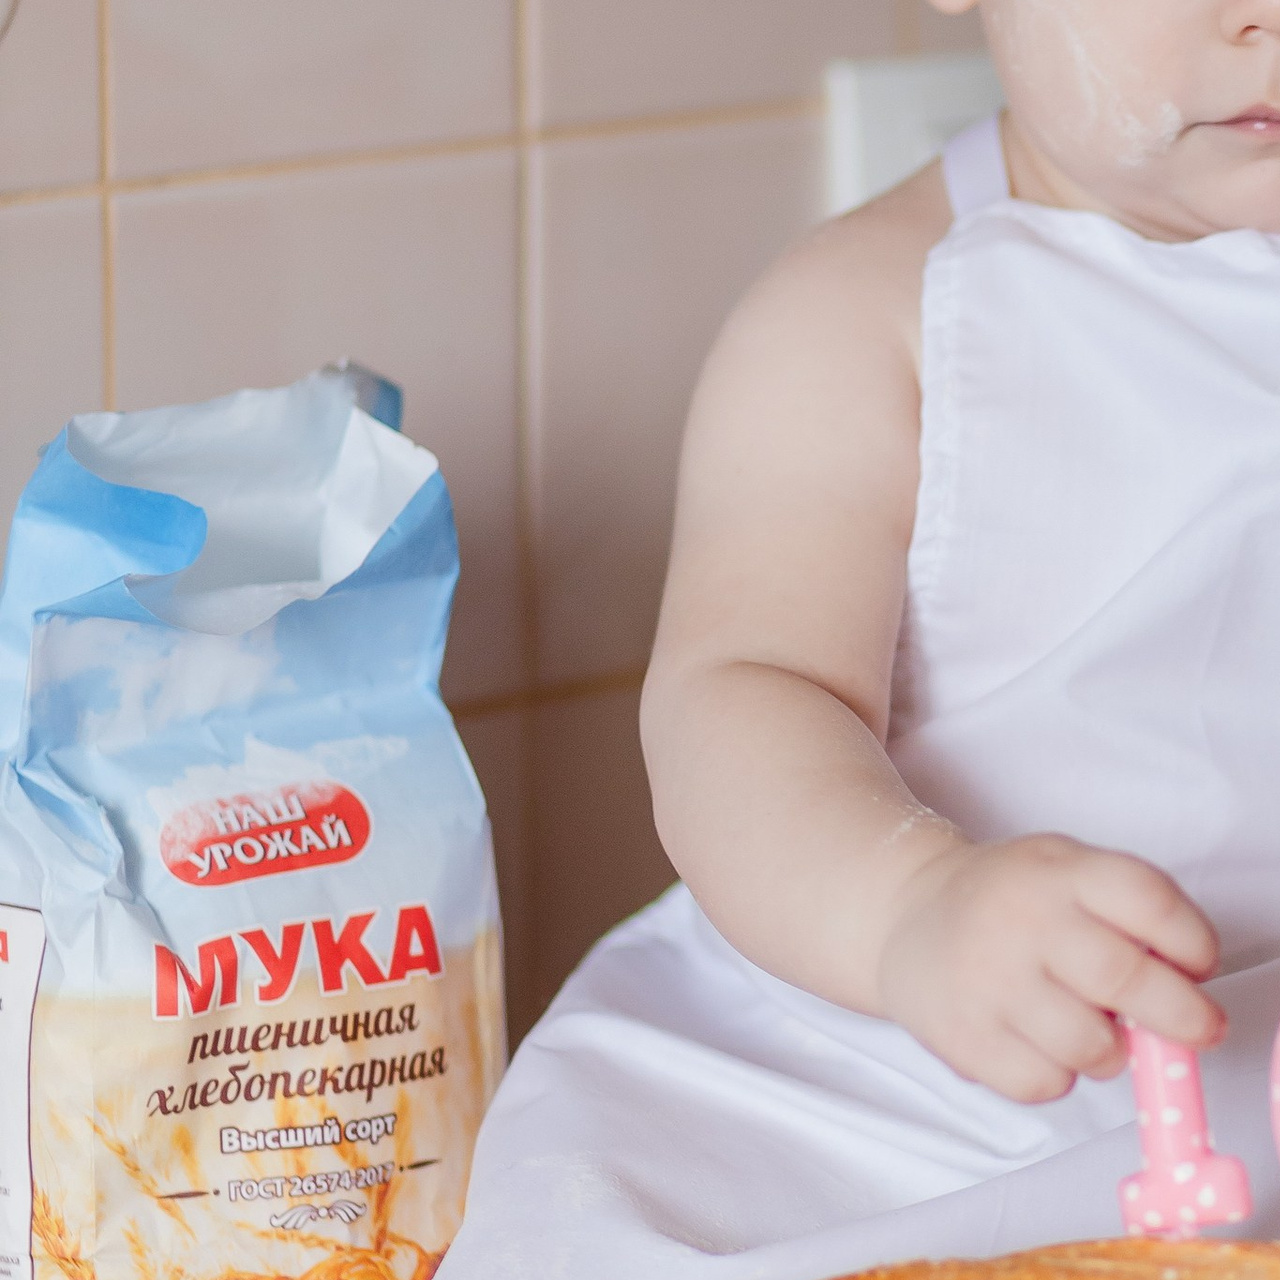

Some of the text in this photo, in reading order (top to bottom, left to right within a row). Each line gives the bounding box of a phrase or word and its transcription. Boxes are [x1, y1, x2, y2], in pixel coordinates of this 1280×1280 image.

[187, 813, 353, 879] УРОЖАЙ
[212, 794, 307, 836] НАШ
[153, 902, 444, 1018] МУКА
[187, 1002, 420, 1065] пшеничная
[146, 1046, 448, 1118] хлебопекарная
[220, 1112, 398, 1154] Высший сорт
[228, 1161, 395, 1202] ГОСТ 26574-2017
